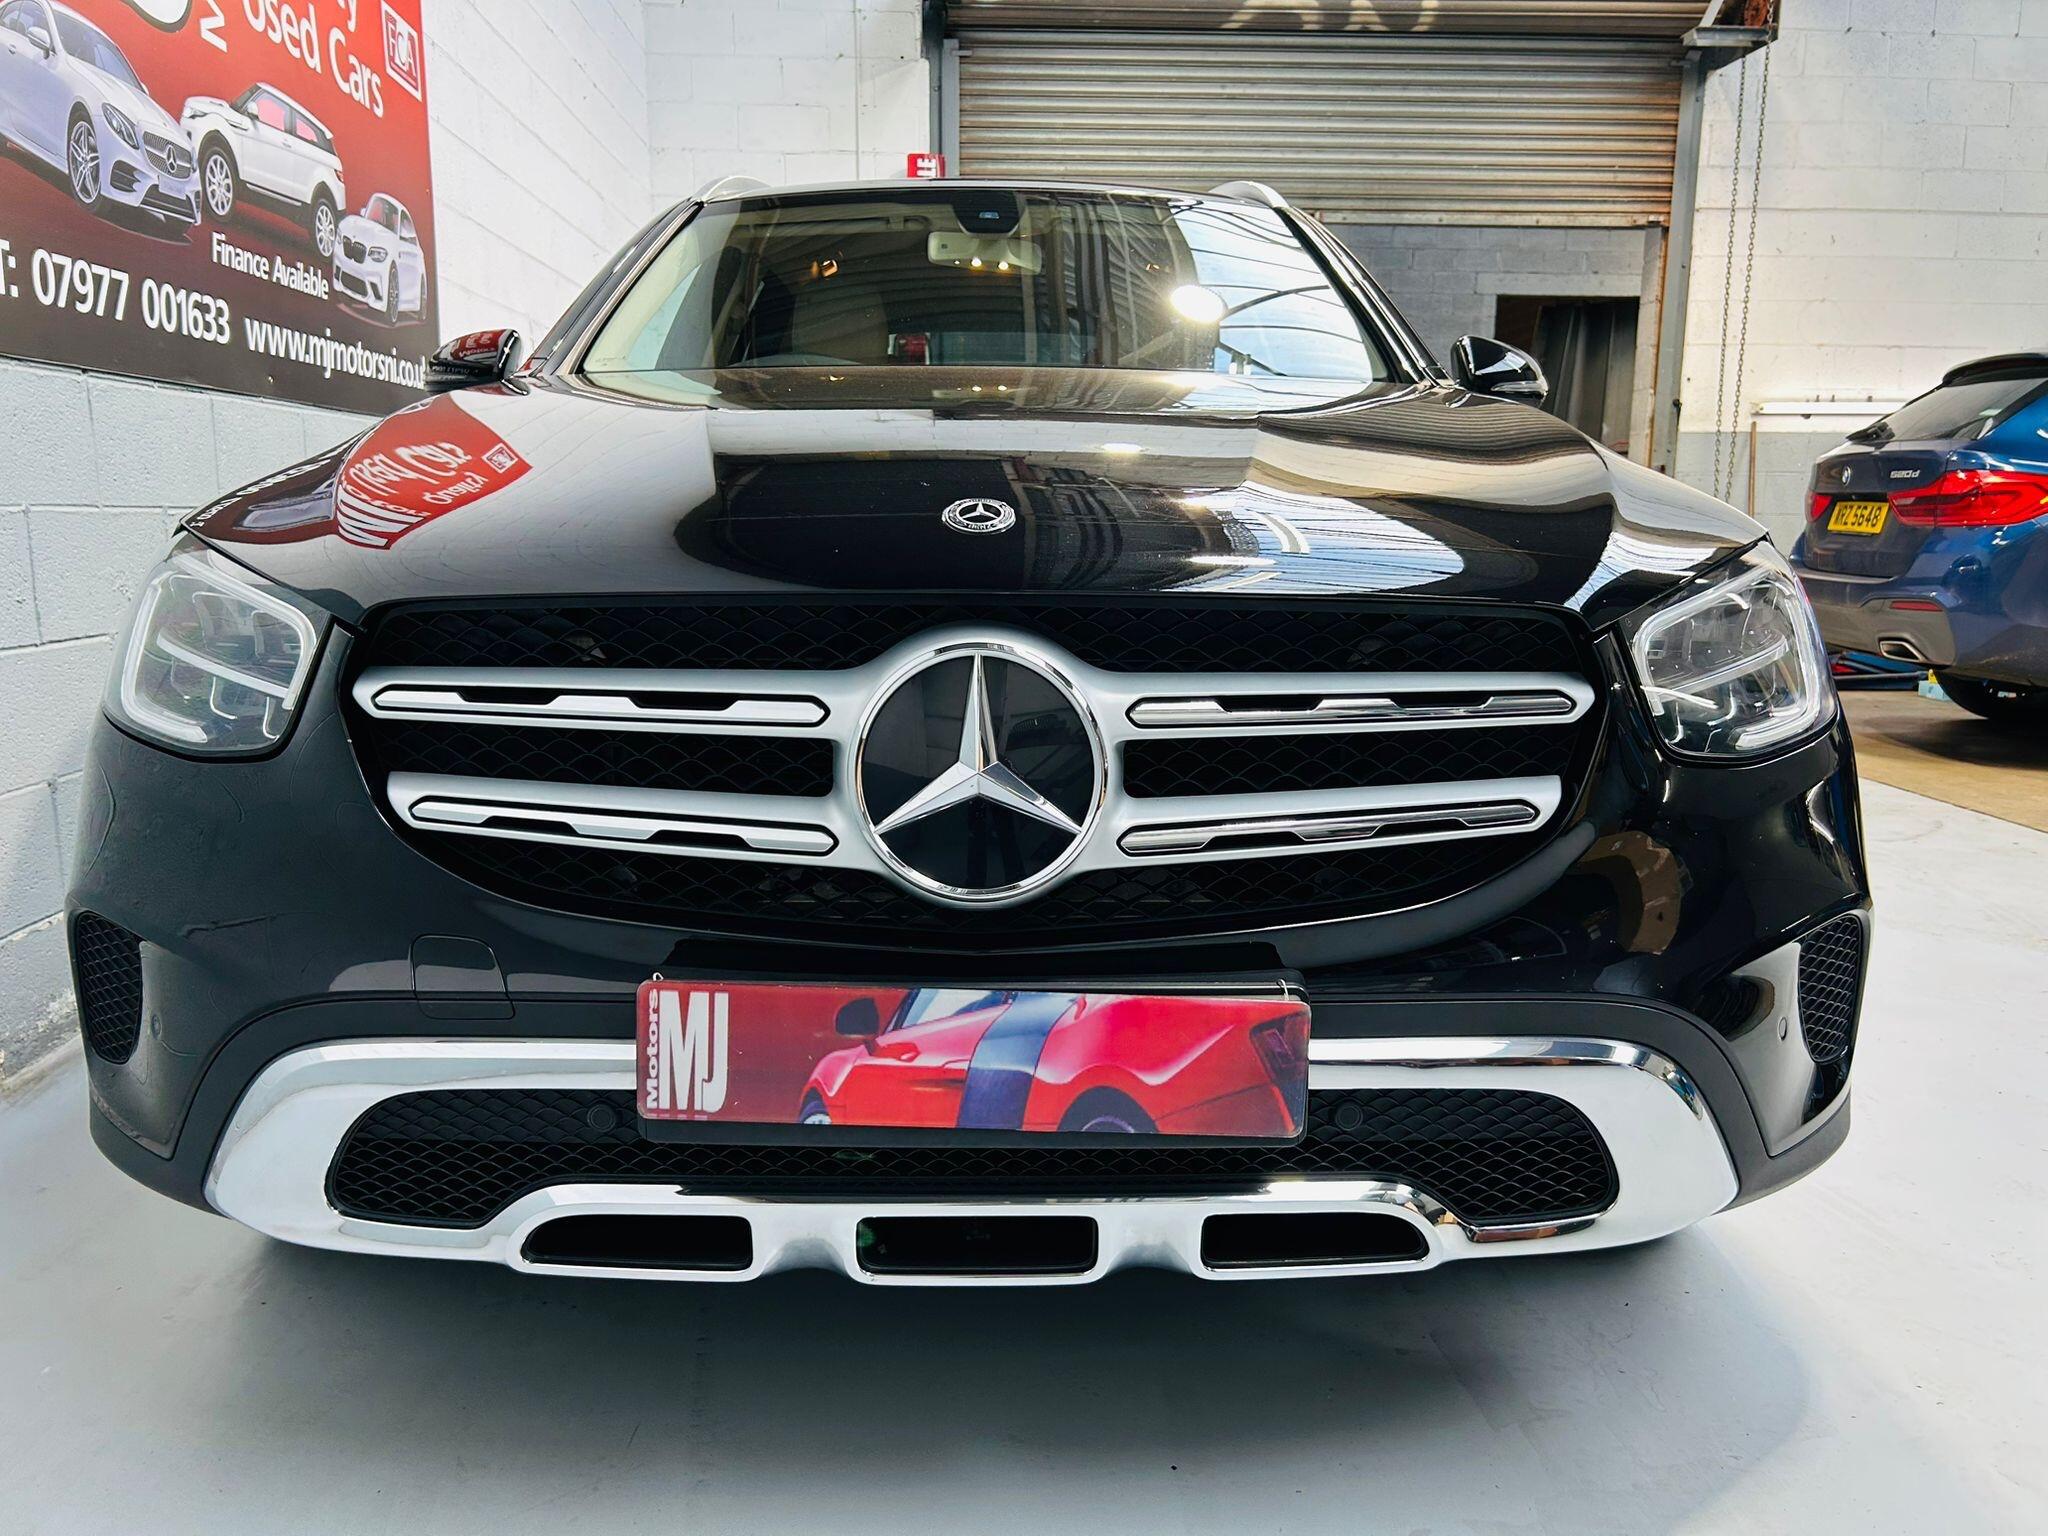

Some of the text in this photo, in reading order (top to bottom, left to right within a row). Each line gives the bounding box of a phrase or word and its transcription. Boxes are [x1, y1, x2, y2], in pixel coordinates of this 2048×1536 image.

[328, 27, 384, 118] Cars
[32, 248, 129, 321] 07977
[141, 278, 230, 345] 001633
[211, 231, 329, 300] Finance Available
[1850, 505, 1882, 528] 5648
[646, 988, 659, 1110] Motors
[659, 989, 729, 1113] MJ
